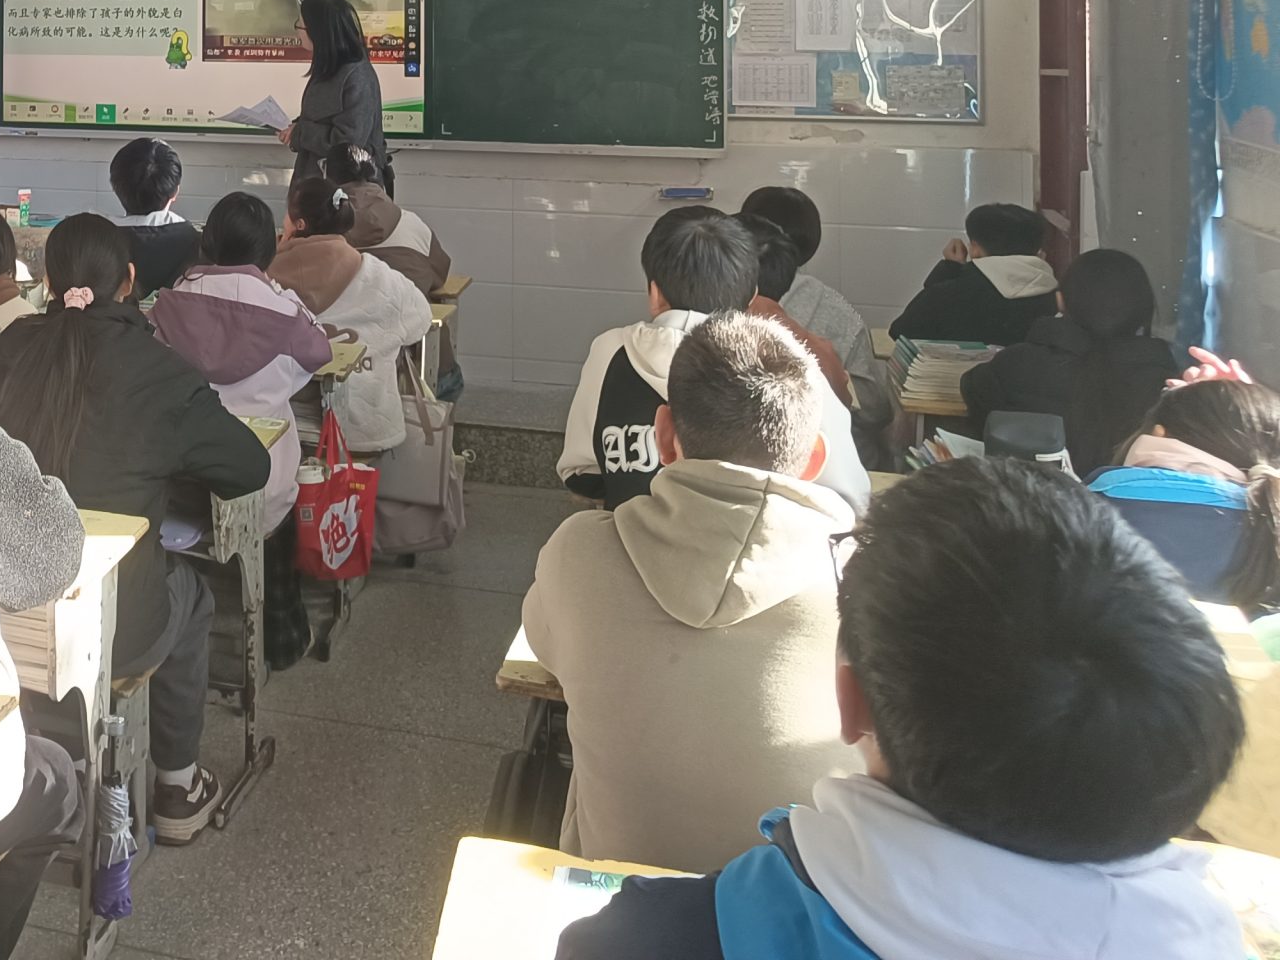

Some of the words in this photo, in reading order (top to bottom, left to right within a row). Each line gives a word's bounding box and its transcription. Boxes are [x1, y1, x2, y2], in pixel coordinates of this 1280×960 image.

[7, 7, 183, 20] 而且专家也排除了孩子的外貌是白
